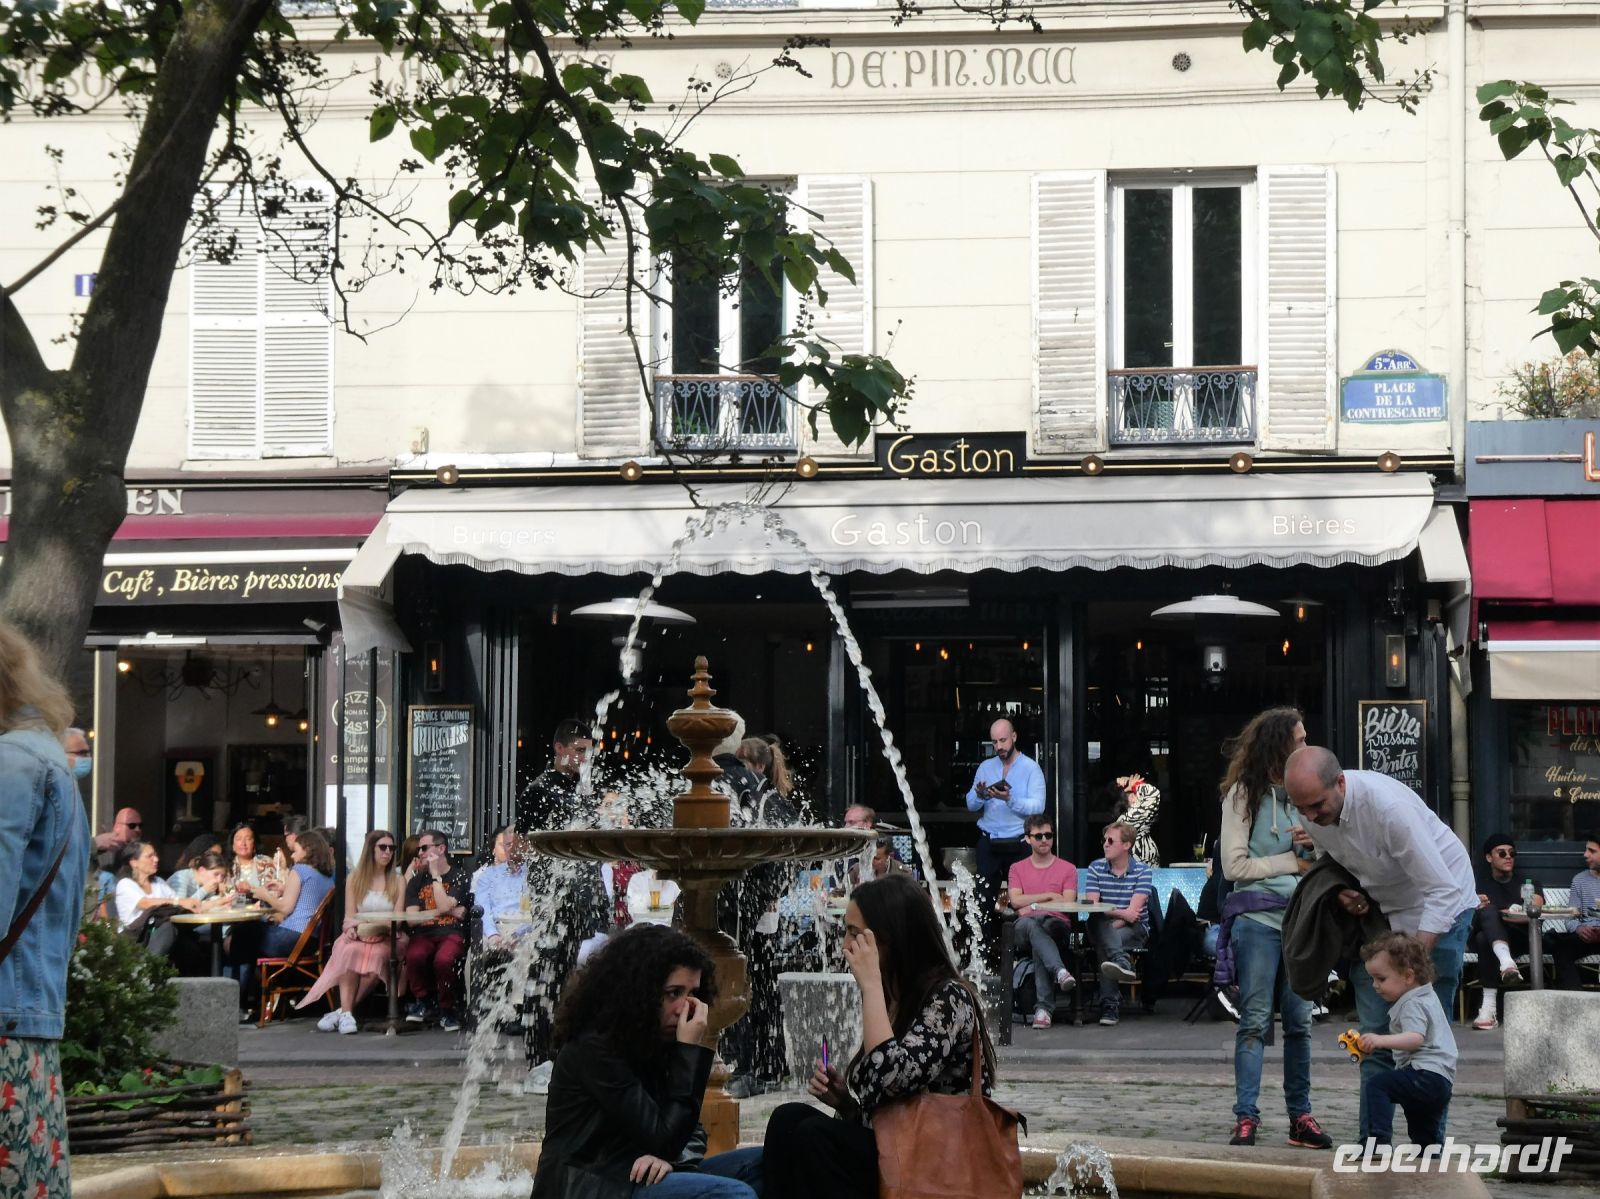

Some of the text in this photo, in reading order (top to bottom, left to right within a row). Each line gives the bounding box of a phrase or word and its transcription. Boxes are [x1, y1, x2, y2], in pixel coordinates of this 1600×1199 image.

[1374, 382, 1416, 394] PLACE
[1376, 395, 1413, 406] DE LA
[1347, 407, 1442, 419] CONTRESCARPE
[887, 434, 1014, 474] Gaston
[453, 526, 555, 550] Burgers
[830, 513, 983, 546] Gaston
[1272, 515, 1356, 536] Bières
[170, 567, 239, 592] Bières
[241, 565, 341, 598] pressions
[1364, 706, 1421, 740] Bières
[413, 724, 469, 756] BURGERS
[1366, 732, 1417, 757] pression
